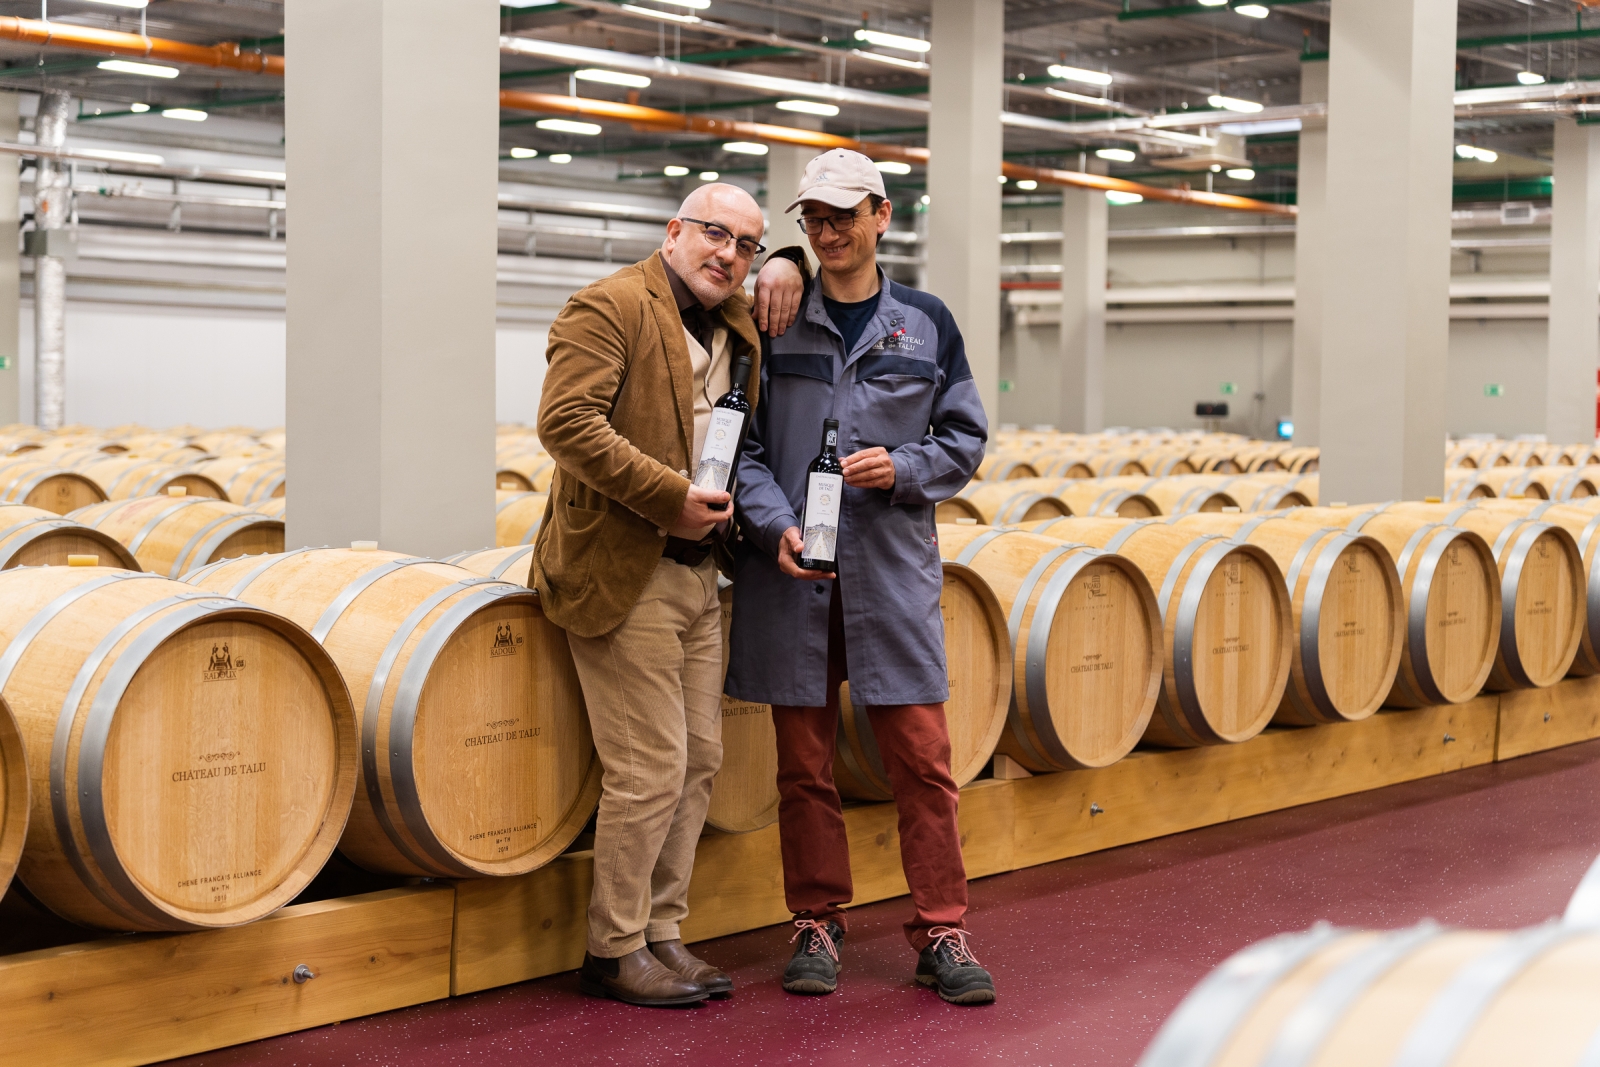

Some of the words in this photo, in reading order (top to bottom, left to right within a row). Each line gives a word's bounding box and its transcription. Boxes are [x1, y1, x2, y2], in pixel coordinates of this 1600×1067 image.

[898, 342, 915, 351] TALU
[490, 647, 517, 656] RADOUX
[1101, 662, 1114, 670] TALU
[203, 670, 237, 681] RADOUX
[721, 707, 739, 717] TEAU
[740, 707, 749, 715] DE
[750, 705, 767, 714] TALU
[506, 731, 517, 741] DE
[519, 727, 541, 738] TALU
[172, 768, 220, 782] CHÂTEAU
[224, 766, 237, 776] DE
[240, 762, 266, 774] TALU
[513, 823, 537, 832] ALLIANCE
[233, 870, 261, 879] ALLIANCE
